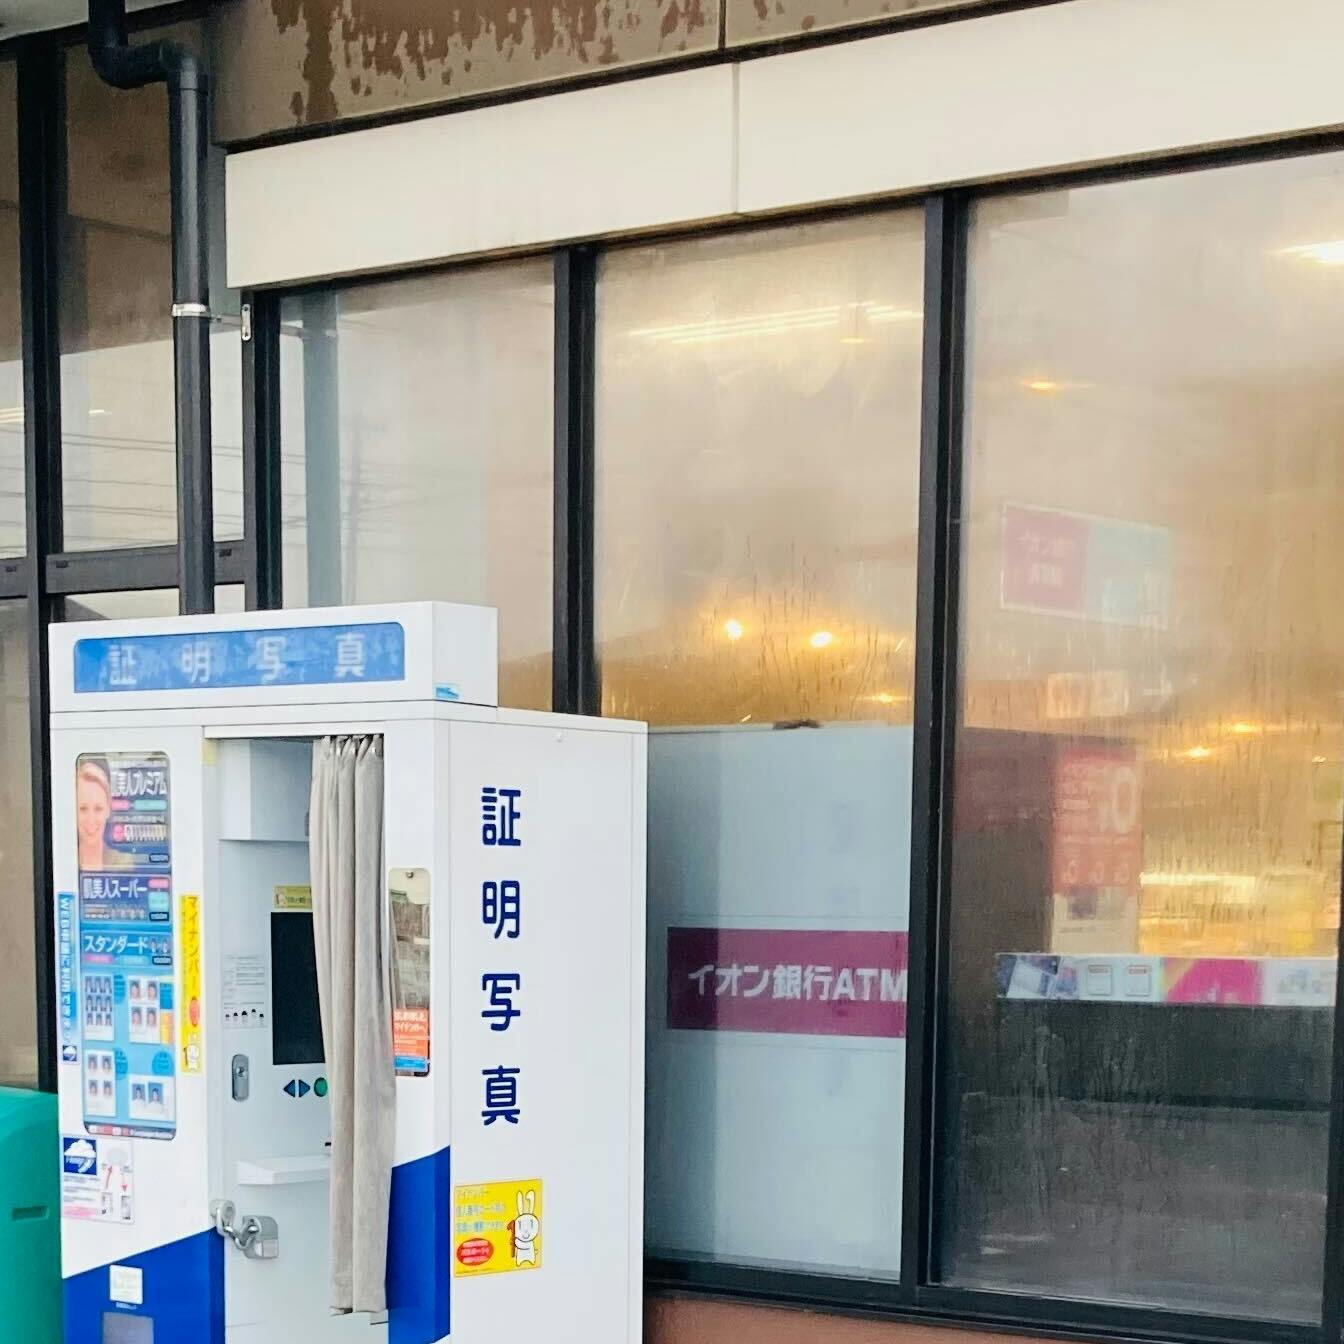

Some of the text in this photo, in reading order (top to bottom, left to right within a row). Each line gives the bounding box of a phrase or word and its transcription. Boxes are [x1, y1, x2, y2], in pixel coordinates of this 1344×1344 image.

[108, 631, 367, 686] 証明写真
[84, 935, 148, 953] スタンダード
[481, 786, 521, 1126] 証明写真
[687, 963, 907, 1002] イオン銀行ATM
